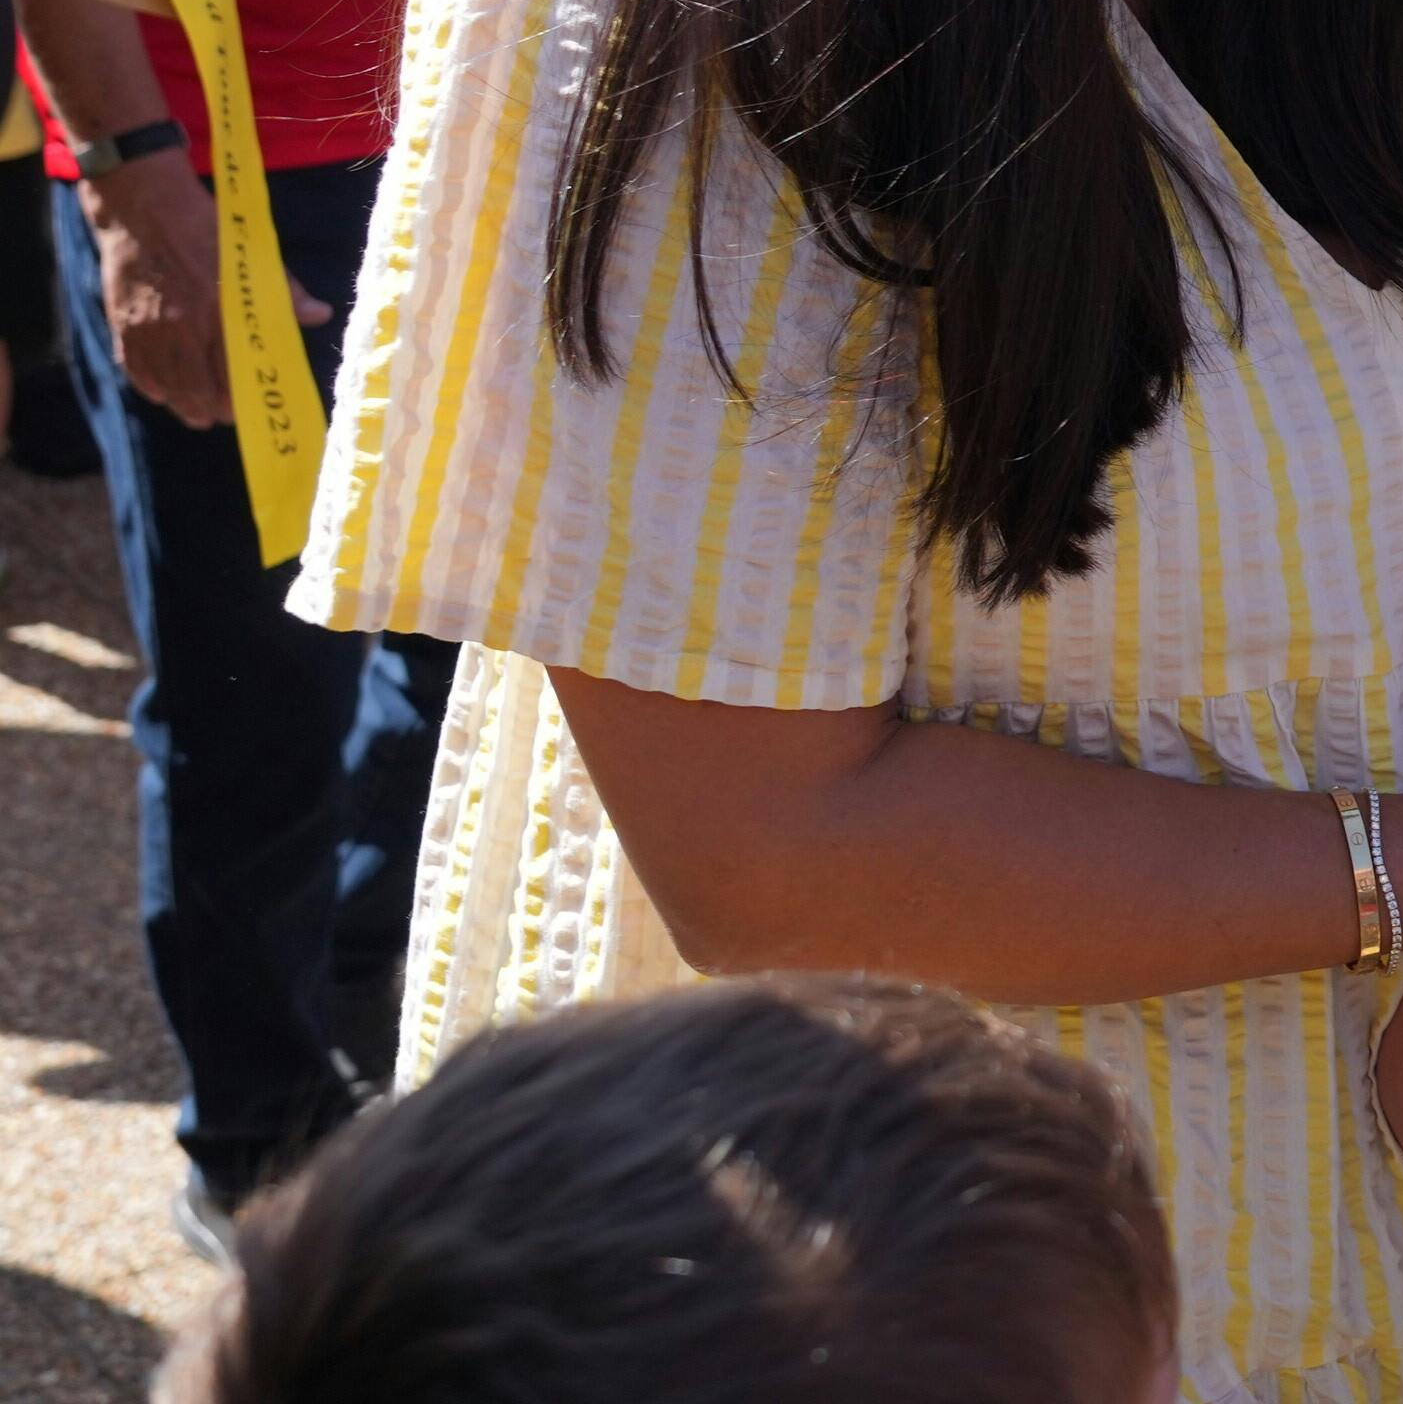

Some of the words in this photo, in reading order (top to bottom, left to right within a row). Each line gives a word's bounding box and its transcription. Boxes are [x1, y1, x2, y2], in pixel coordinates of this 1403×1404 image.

[224, 149, 241, 196] de
[231, 212, 265, 352] France
[256, 366, 297, 456] 2023
